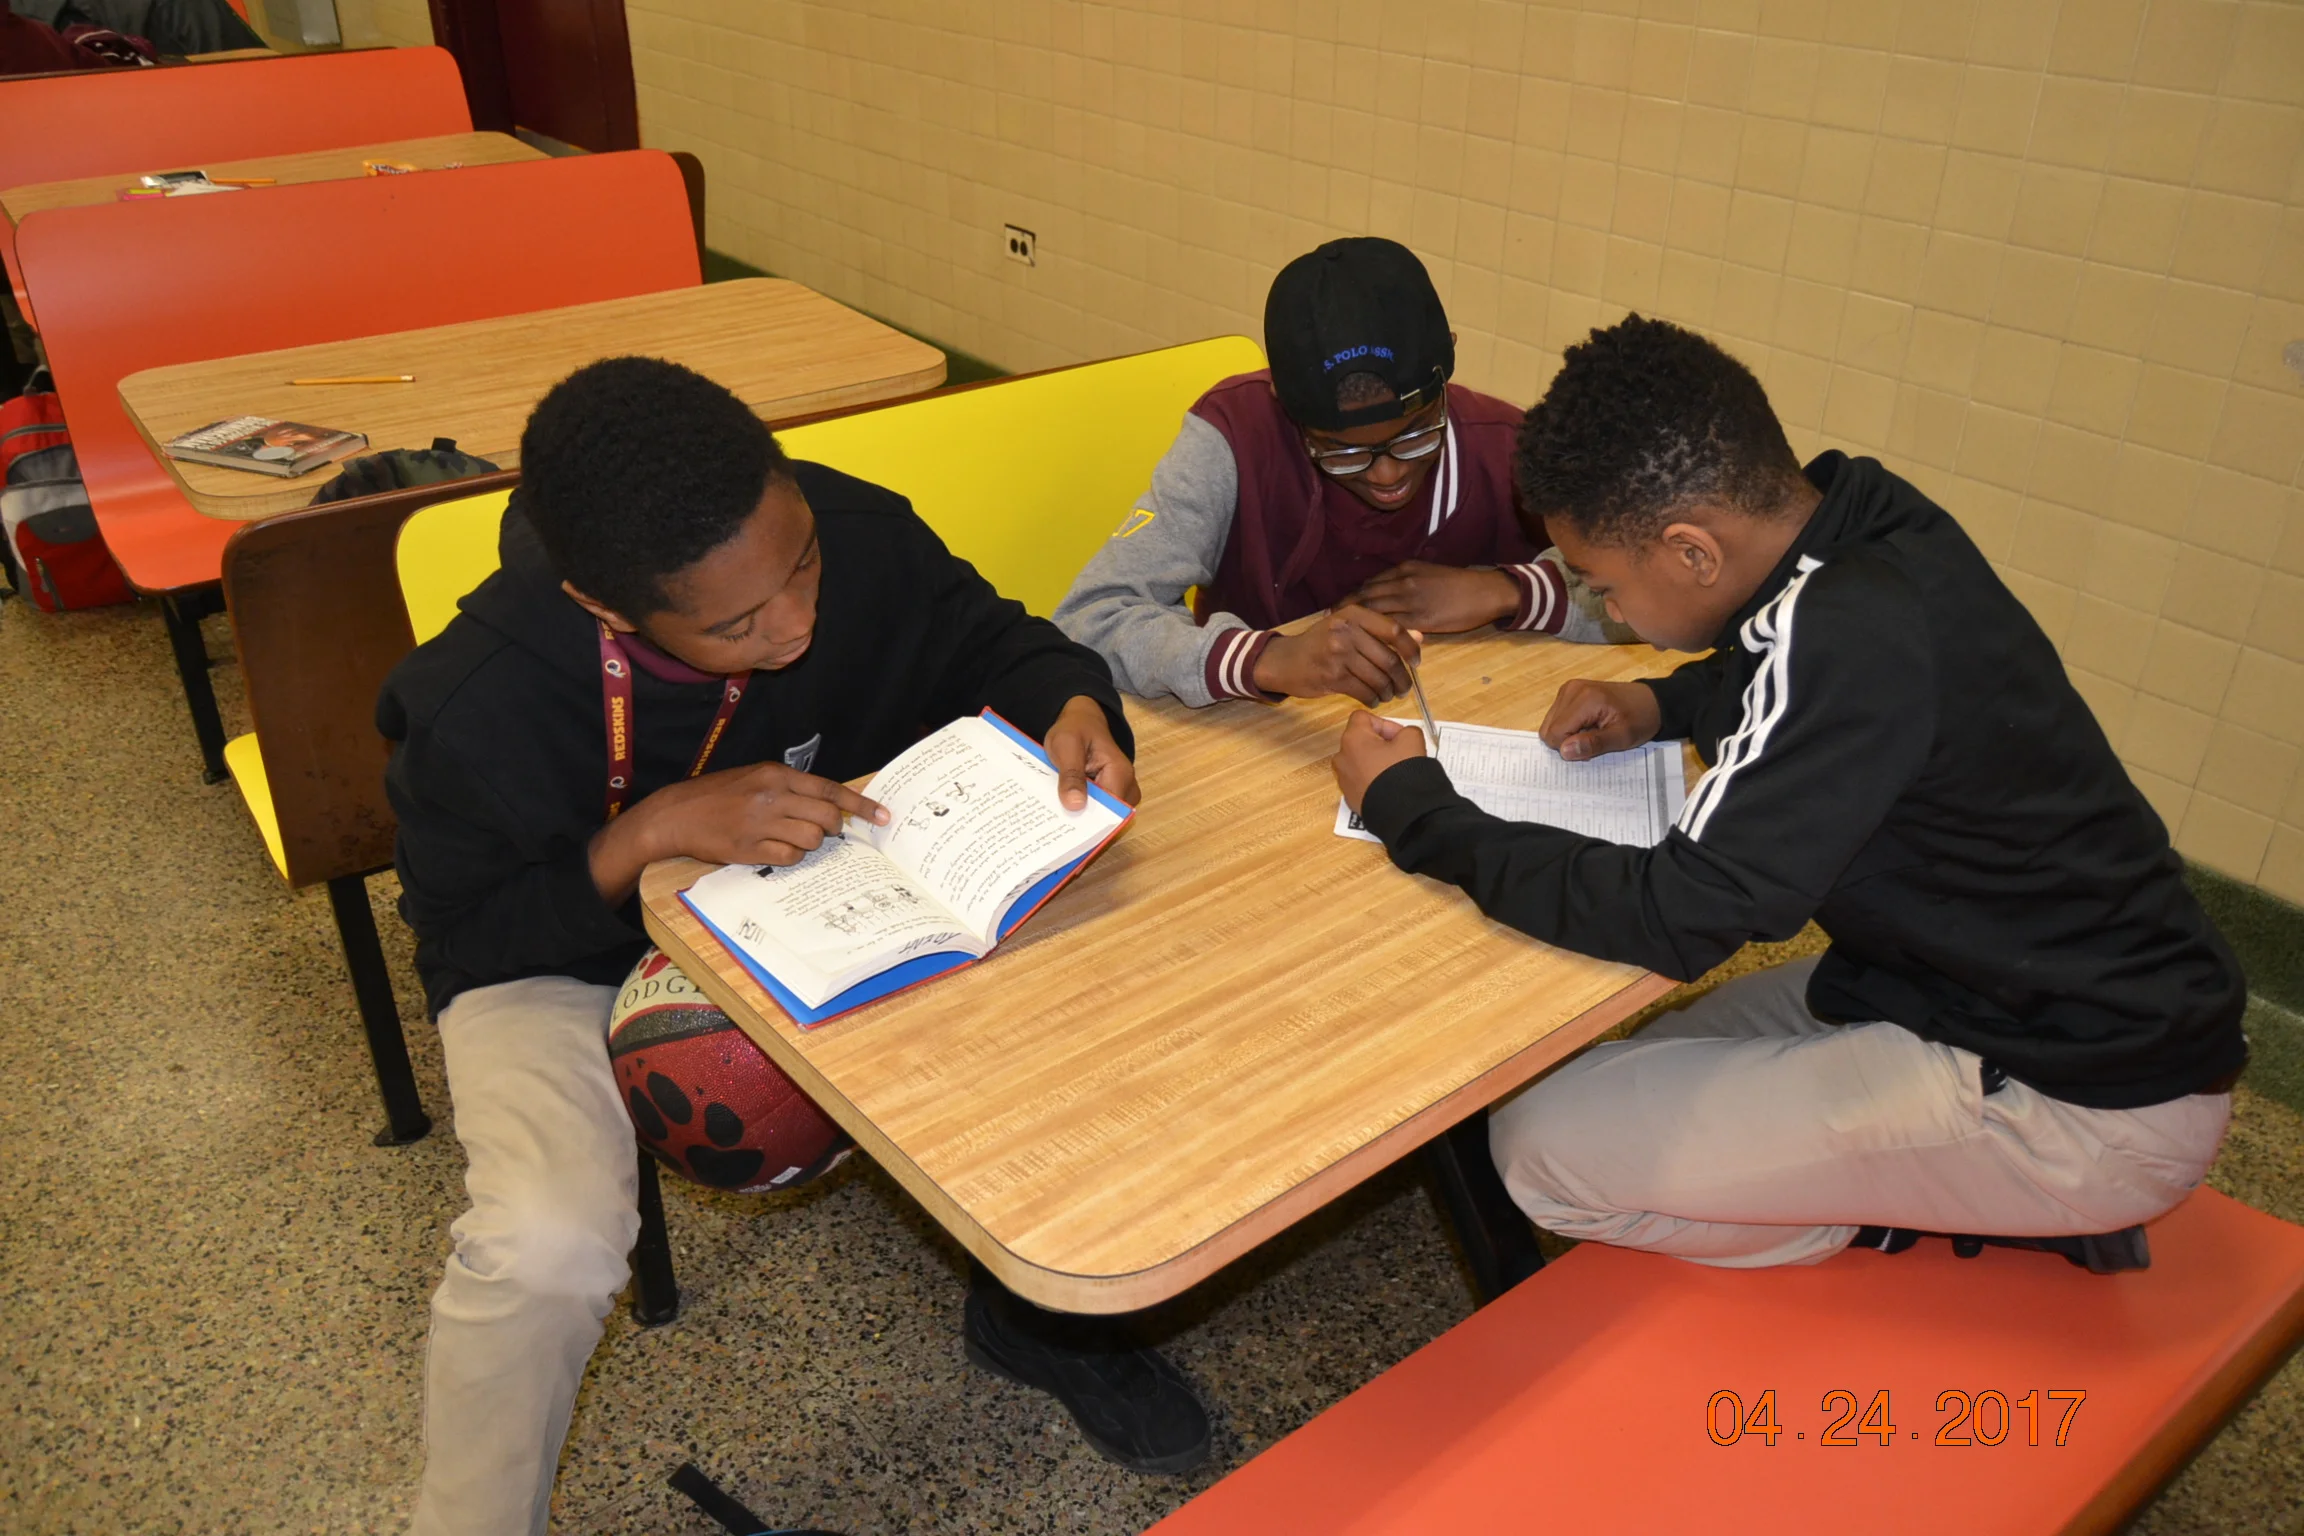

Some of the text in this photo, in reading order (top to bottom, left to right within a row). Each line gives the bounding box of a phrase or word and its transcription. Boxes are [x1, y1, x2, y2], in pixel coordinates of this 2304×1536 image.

[1333, 345, 1368, 364] POLO
[611, 696, 626, 762] REDSKINS
[691, 718, 727, 777] REDSKINS
